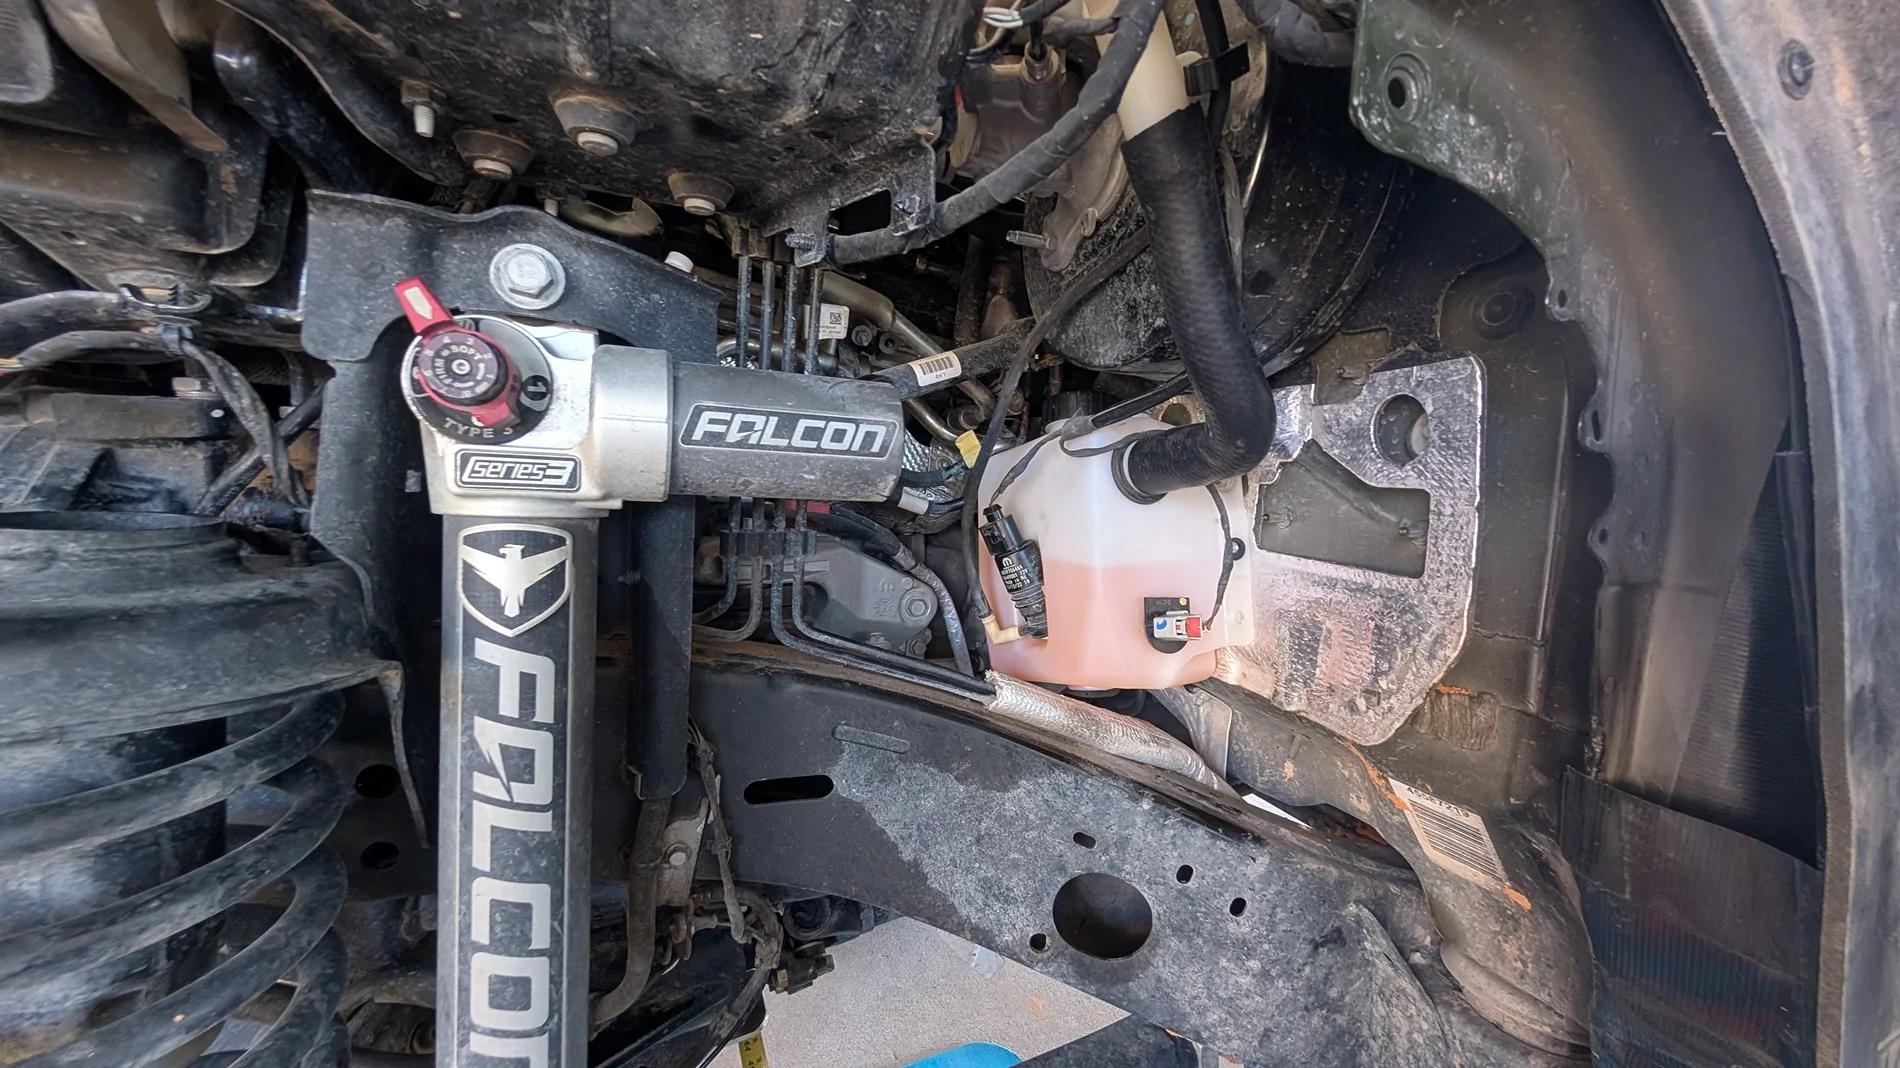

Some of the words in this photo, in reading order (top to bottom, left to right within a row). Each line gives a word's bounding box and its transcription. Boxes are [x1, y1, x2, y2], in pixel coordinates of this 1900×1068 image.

[450, 345, 482, 360] SOFT
[434, 358, 453, 384] FIRM
[527, 382, 547, 393] 1
[443, 417, 494, 438] TYPE
[692, 410, 887, 453] FALCON
